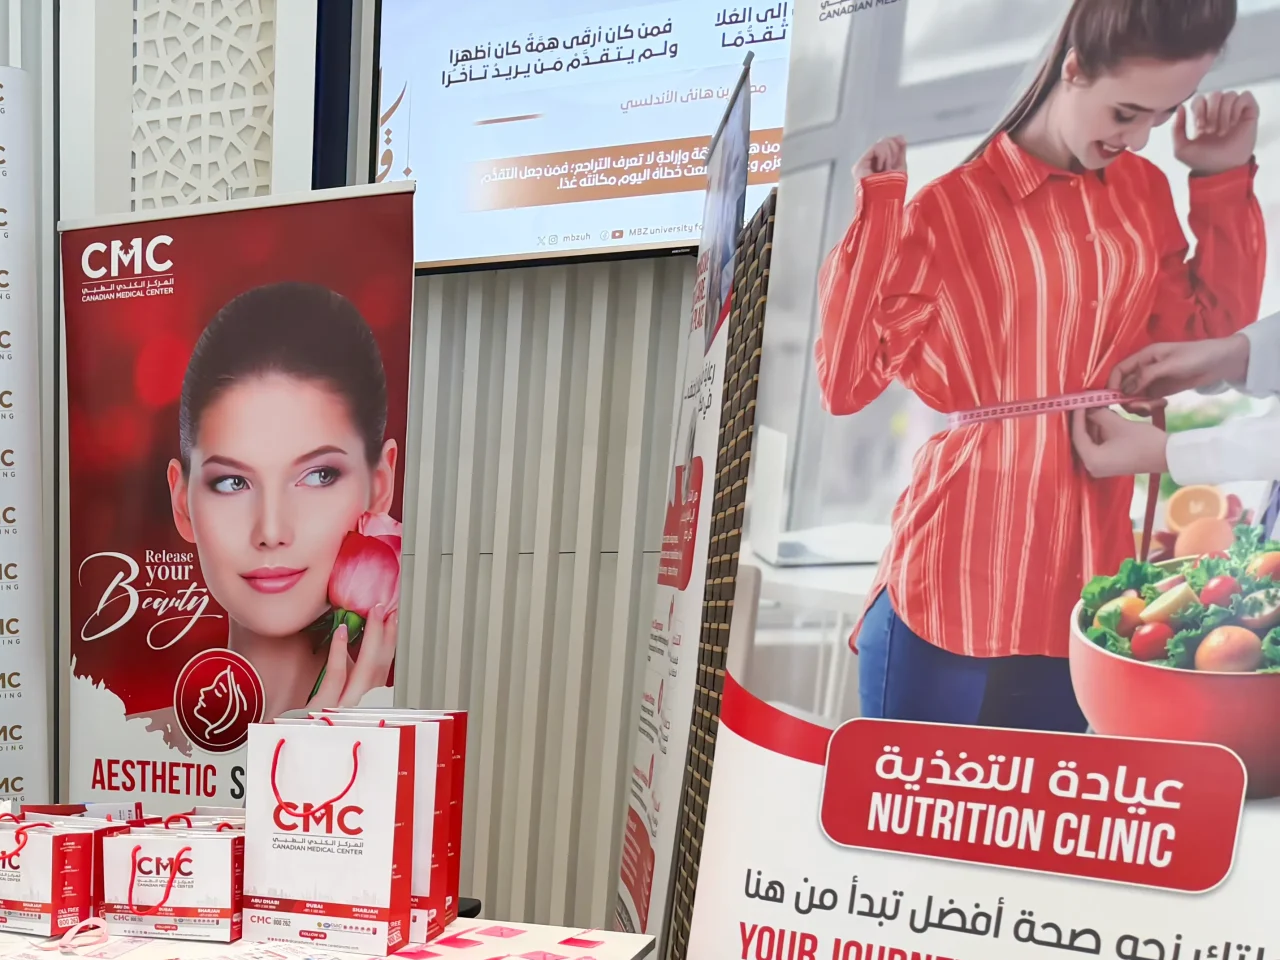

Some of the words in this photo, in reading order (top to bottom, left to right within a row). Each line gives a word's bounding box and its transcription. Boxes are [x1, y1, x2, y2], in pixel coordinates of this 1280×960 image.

[605, 24, 634, 44] كان
[638, 18, 672, 39] فمن
[494, 40, 521, 59] كان
[563, 233, 590, 243] mbzuh
[629, 228, 648, 237] MBZ
[650, 224, 693, 238] university
[81, 235, 173, 278] CMC
[82, 284, 115, 294] الطبي
[82, 293, 115, 302] CANADIAN
[116, 290, 145, 299] MEDICAL
[146, 288, 173, 297] CENTER
[116, 281, 145, 290] الكندي
[146, 277, 174, 288] المركز
[145, 550, 193, 563] Release
[145, 565, 193, 587] your
[79, 551, 223, 650] Beauty
[91, 758, 216, 797] AESTHETIC
[875, 745, 1034, 793] التغذية
[1049, 760, 1184, 815] عيادة
[273, 802, 364, 835] CMC
[868, 792, 1045, 851] NUTRITION
[1053, 812, 1175, 868] CLINIC
[272, 844, 305, 852] CANADIAN
[745, 868, 785, 903] هنا
[794, 877, 838, 915] من
[848, 875, 904, 927] تبدأ
[909, 895, 1004, 938] أفضل
[1013, 910, 1101, 955] صحة
